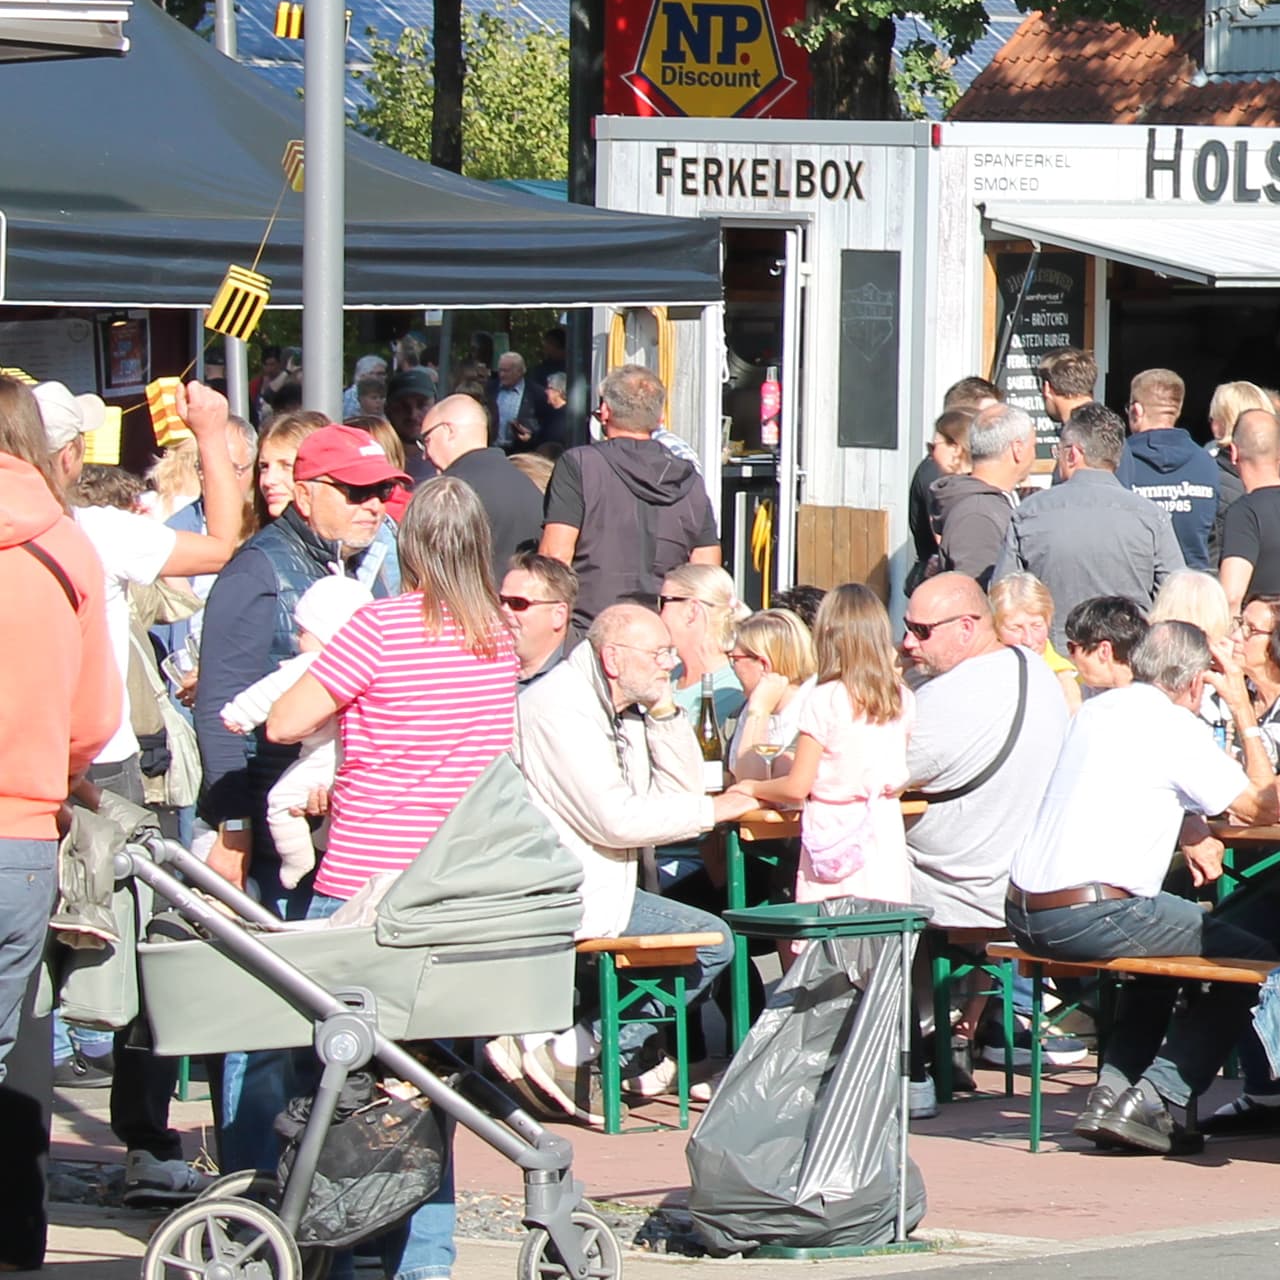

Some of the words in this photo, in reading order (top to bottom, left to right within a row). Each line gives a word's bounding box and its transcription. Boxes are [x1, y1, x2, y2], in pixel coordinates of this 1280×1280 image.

[661, 66, 761, 88] Discount
[974, 153, 1072, 168] SPANFERKEL
[656, 147, 865, 201] FERKELBOX
[974, 177, 1040, 191] SMOKED
